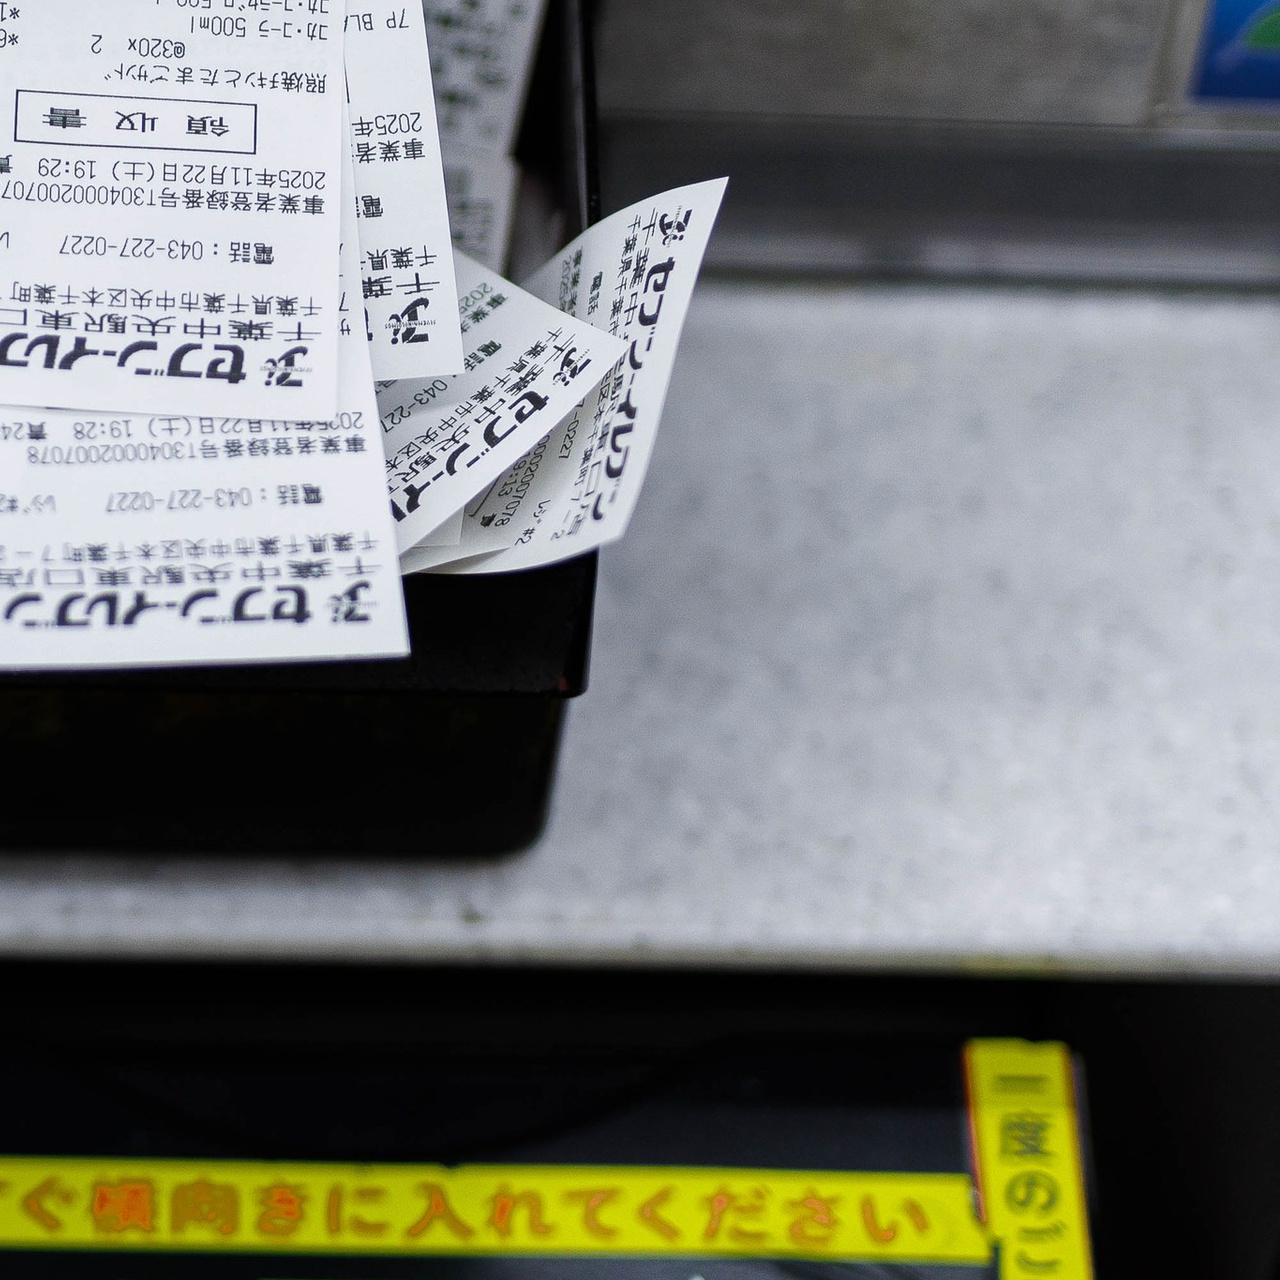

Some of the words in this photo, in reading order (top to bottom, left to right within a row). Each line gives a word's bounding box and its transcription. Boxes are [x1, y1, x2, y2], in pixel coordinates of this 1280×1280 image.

[190, 15, 246, 37] 500ml
[91, 35, 102, 53] 2
[351, 138, 425, 163] 事業者
[38, 157, 96, 179] 19:29
[360, 245, 437, 271] 千葉県
[387, 334, 575, 494] 千葉中央駅
[72, 418, 132, 438] 19:28
